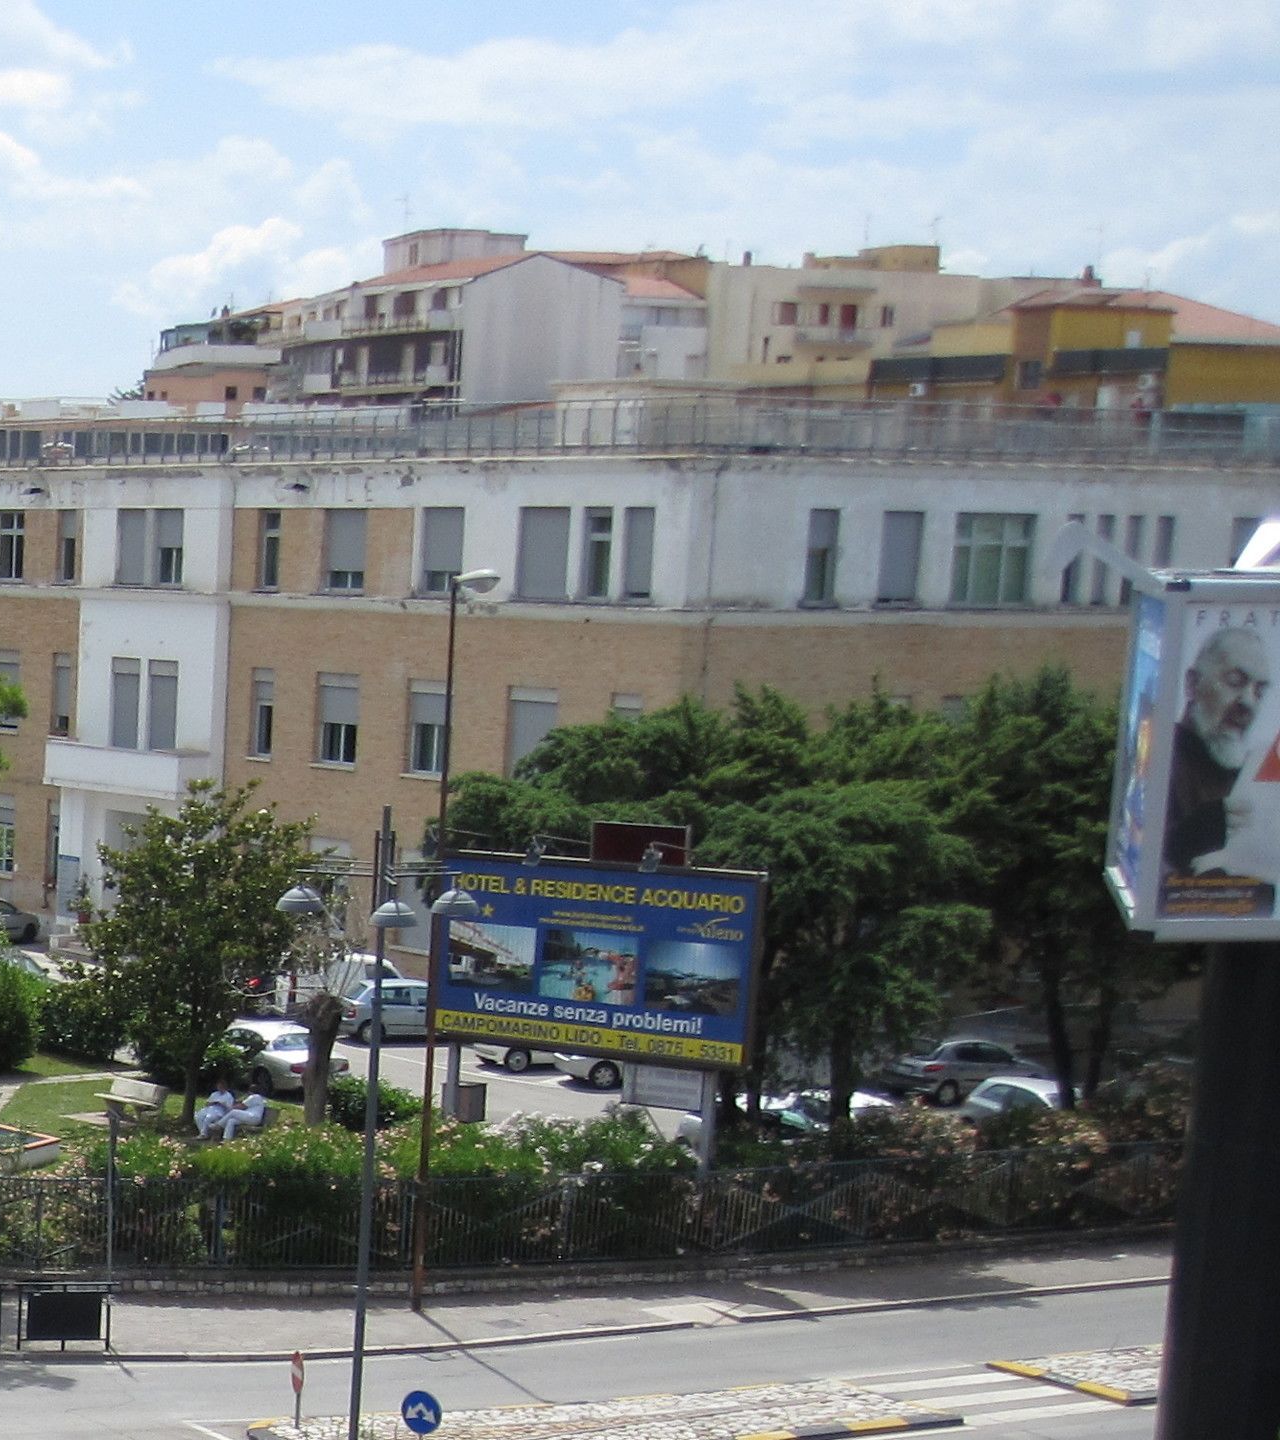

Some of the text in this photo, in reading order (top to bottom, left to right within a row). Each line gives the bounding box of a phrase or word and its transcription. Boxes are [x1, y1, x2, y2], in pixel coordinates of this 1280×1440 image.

[455, 873, 746, 914] HOTEL & RESIDENCE ACQUARIO
[442, 1014, 560, 1040] CAMPOMARINO
[564, 1029, 602, 1045] LIDO
[474, 992, 703, 1035] Vacanze senza problemi!
